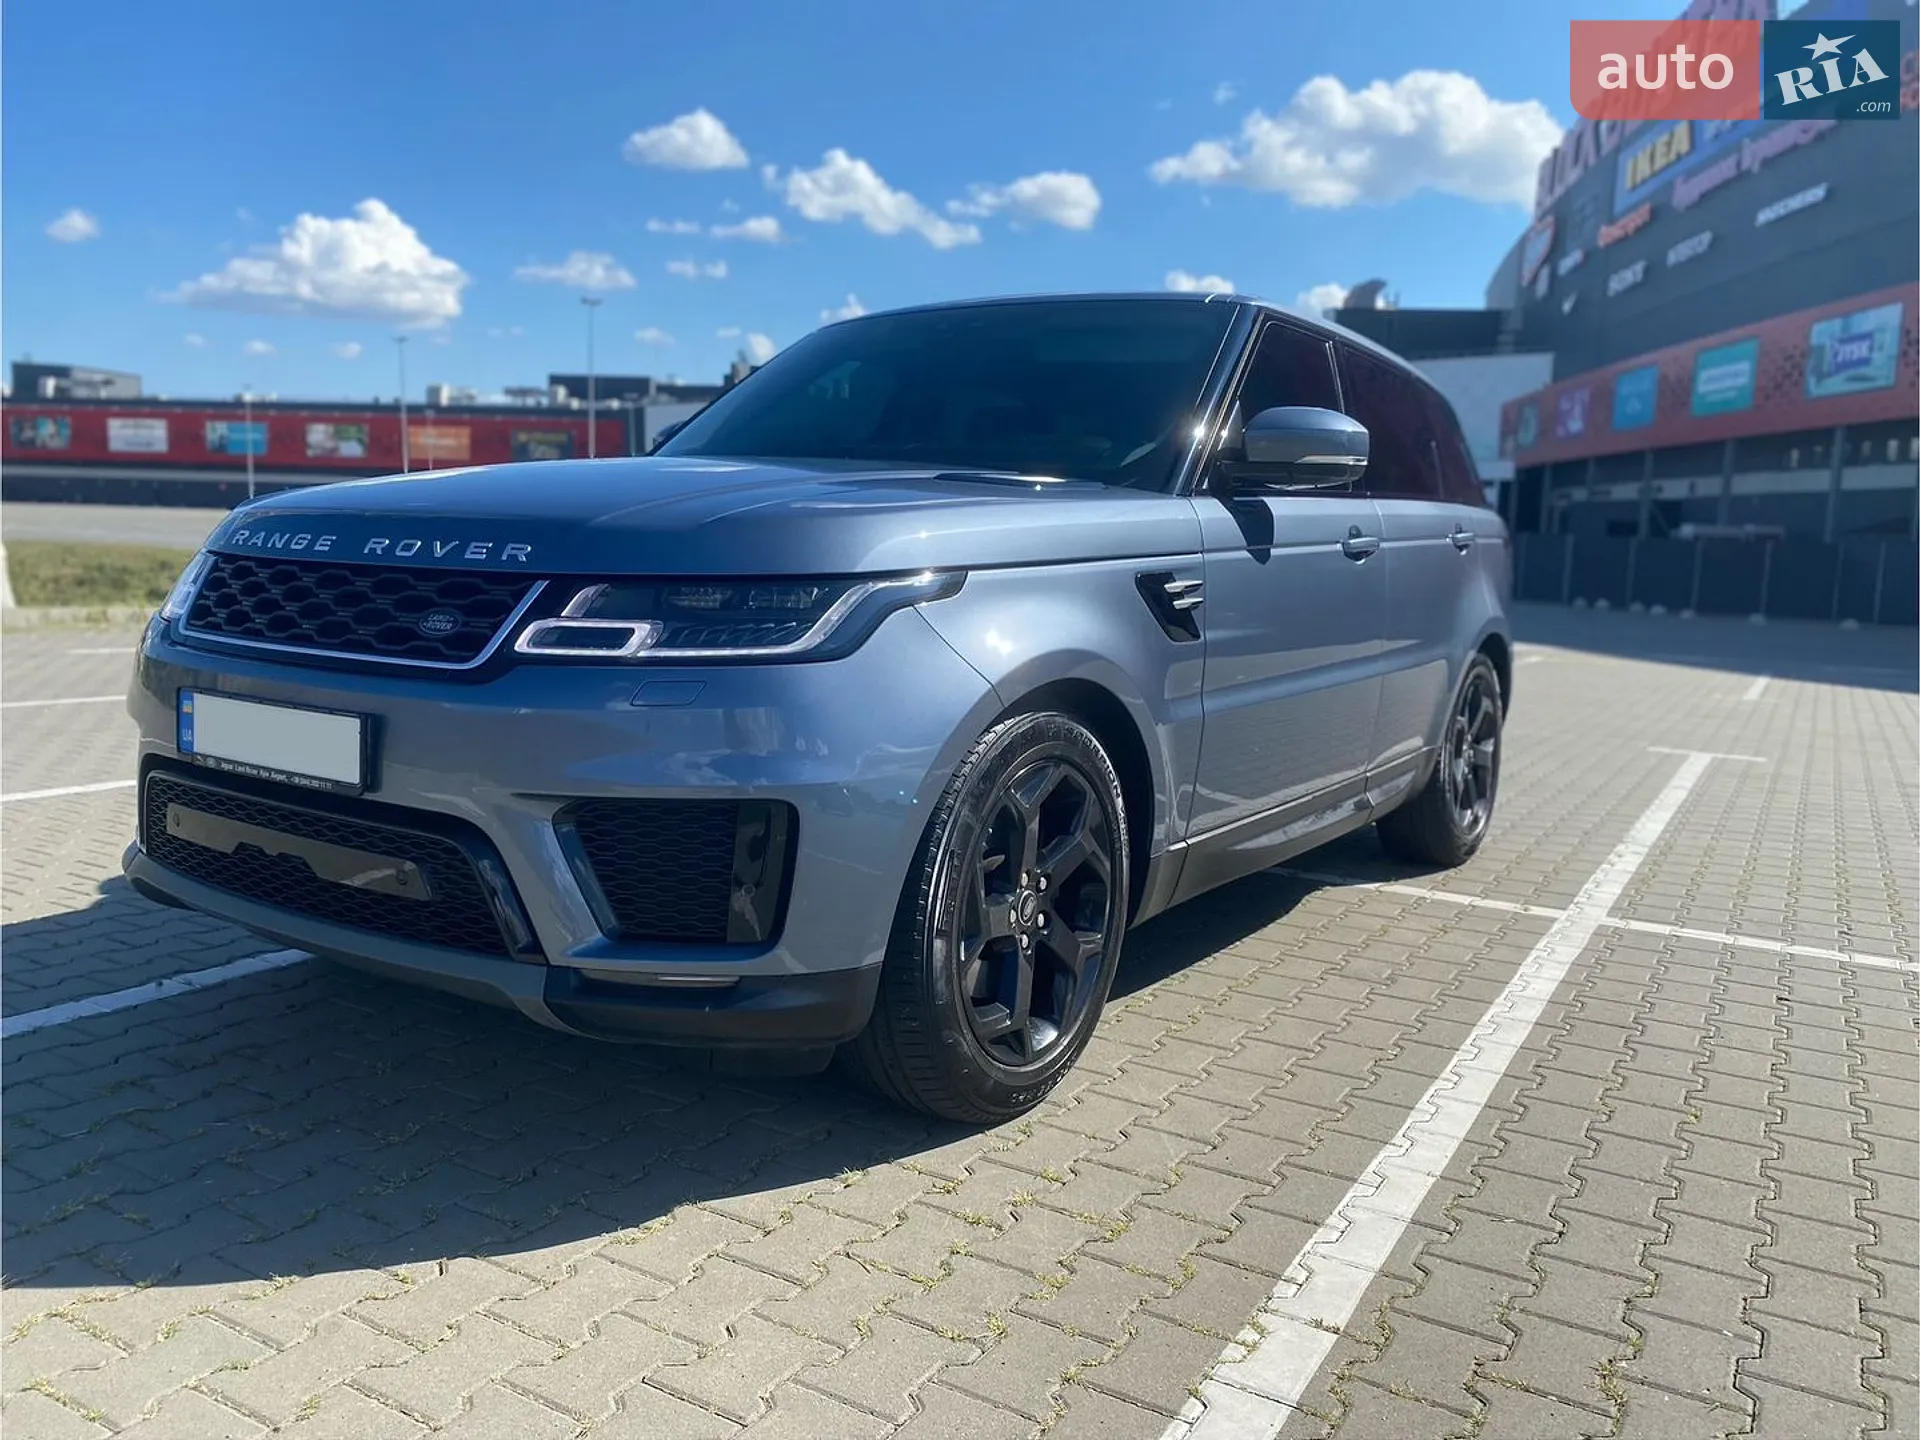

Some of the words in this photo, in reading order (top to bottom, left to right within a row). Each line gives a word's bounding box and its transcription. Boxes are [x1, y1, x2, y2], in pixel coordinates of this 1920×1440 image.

[1625, 119, 1692, 191] IKEA
[233, 530, 337, 551] RANGE
[363, 537, 532, 561] ROVER
